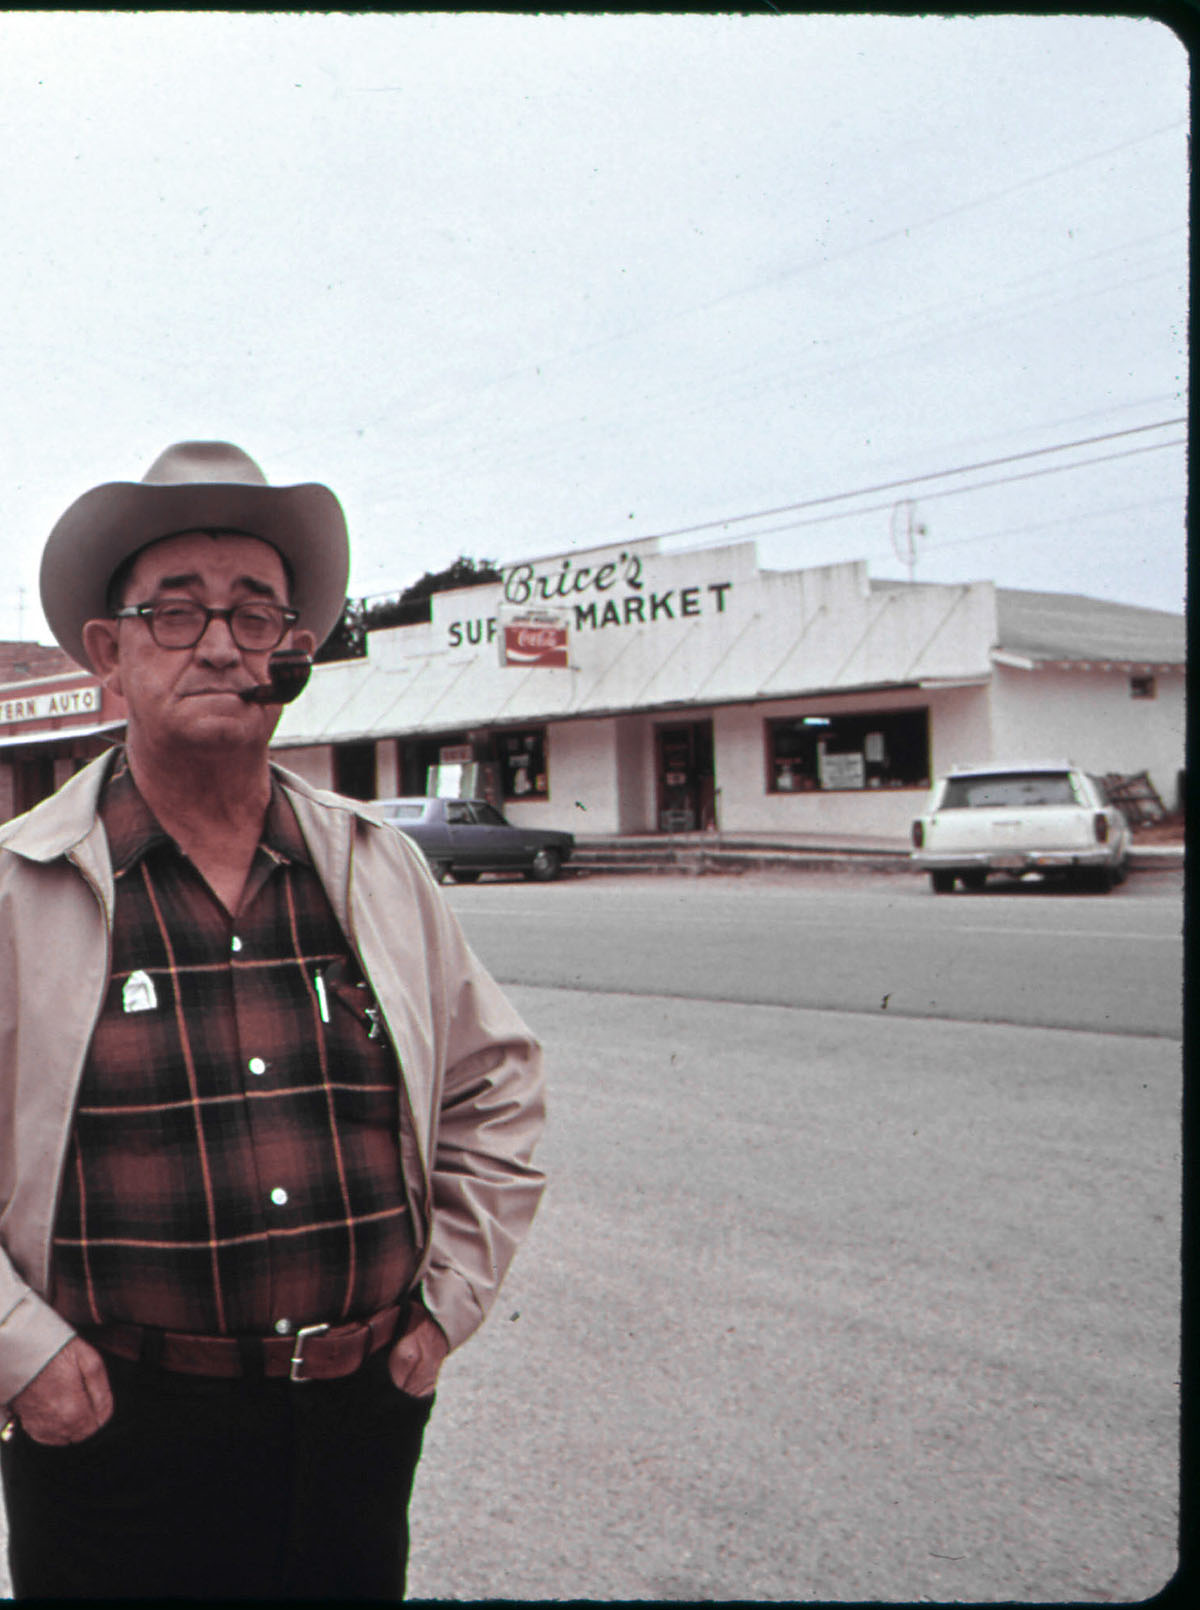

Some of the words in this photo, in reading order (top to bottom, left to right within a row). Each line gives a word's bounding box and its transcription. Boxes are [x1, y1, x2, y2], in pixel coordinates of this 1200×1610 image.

[500, 552, 643, 604] Brice's
[449, 617, 497, 647] SUP
[574, 583, 733, 631] MARKET
[48, 691, 94, 713] AUTO
